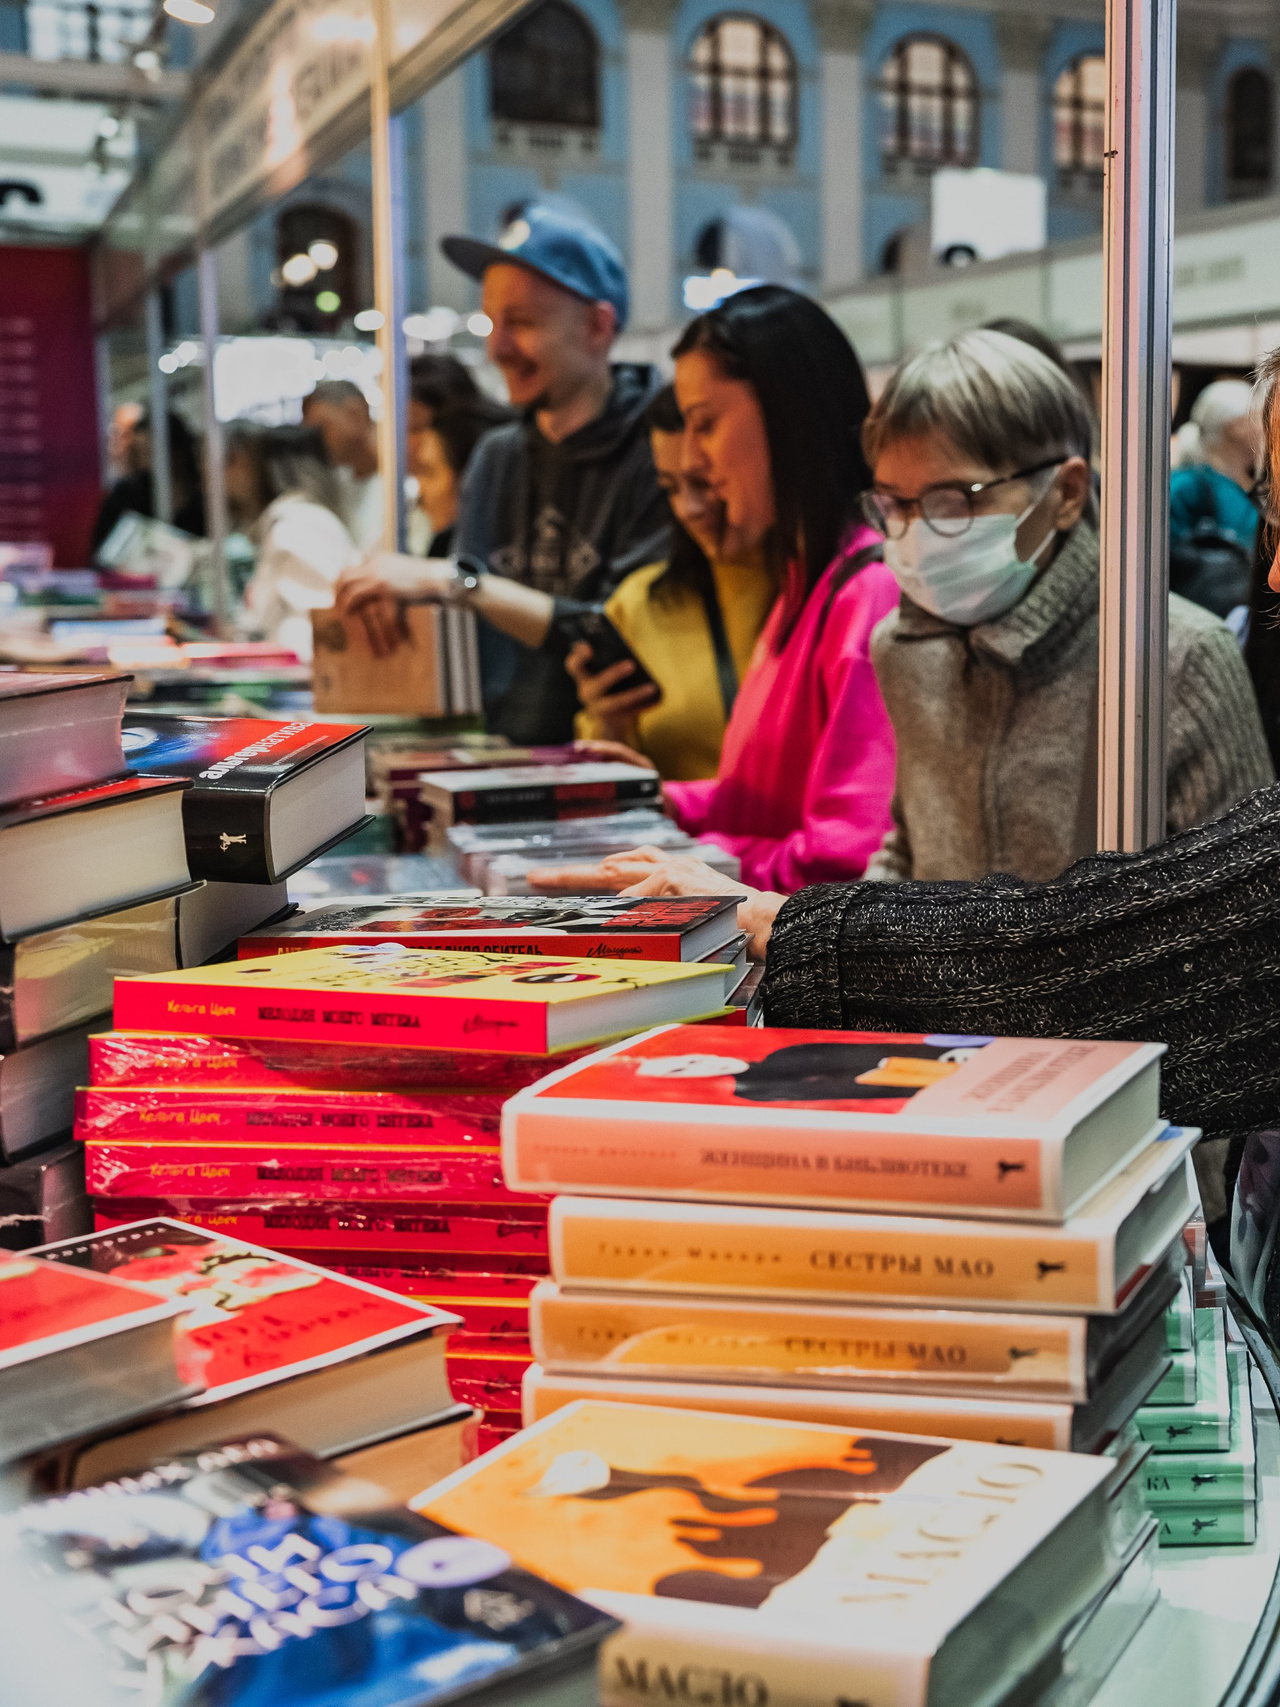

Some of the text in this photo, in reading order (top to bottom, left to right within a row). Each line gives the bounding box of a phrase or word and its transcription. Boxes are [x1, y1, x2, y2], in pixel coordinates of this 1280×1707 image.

[810, 1249, 922, 1276] СЕСТРЫ
[935, 1256, 995, 1280] МАО
[785, 1335, 895, 1361] СЕСТРЫ
[907, 1341, 968, 1365] МАО
